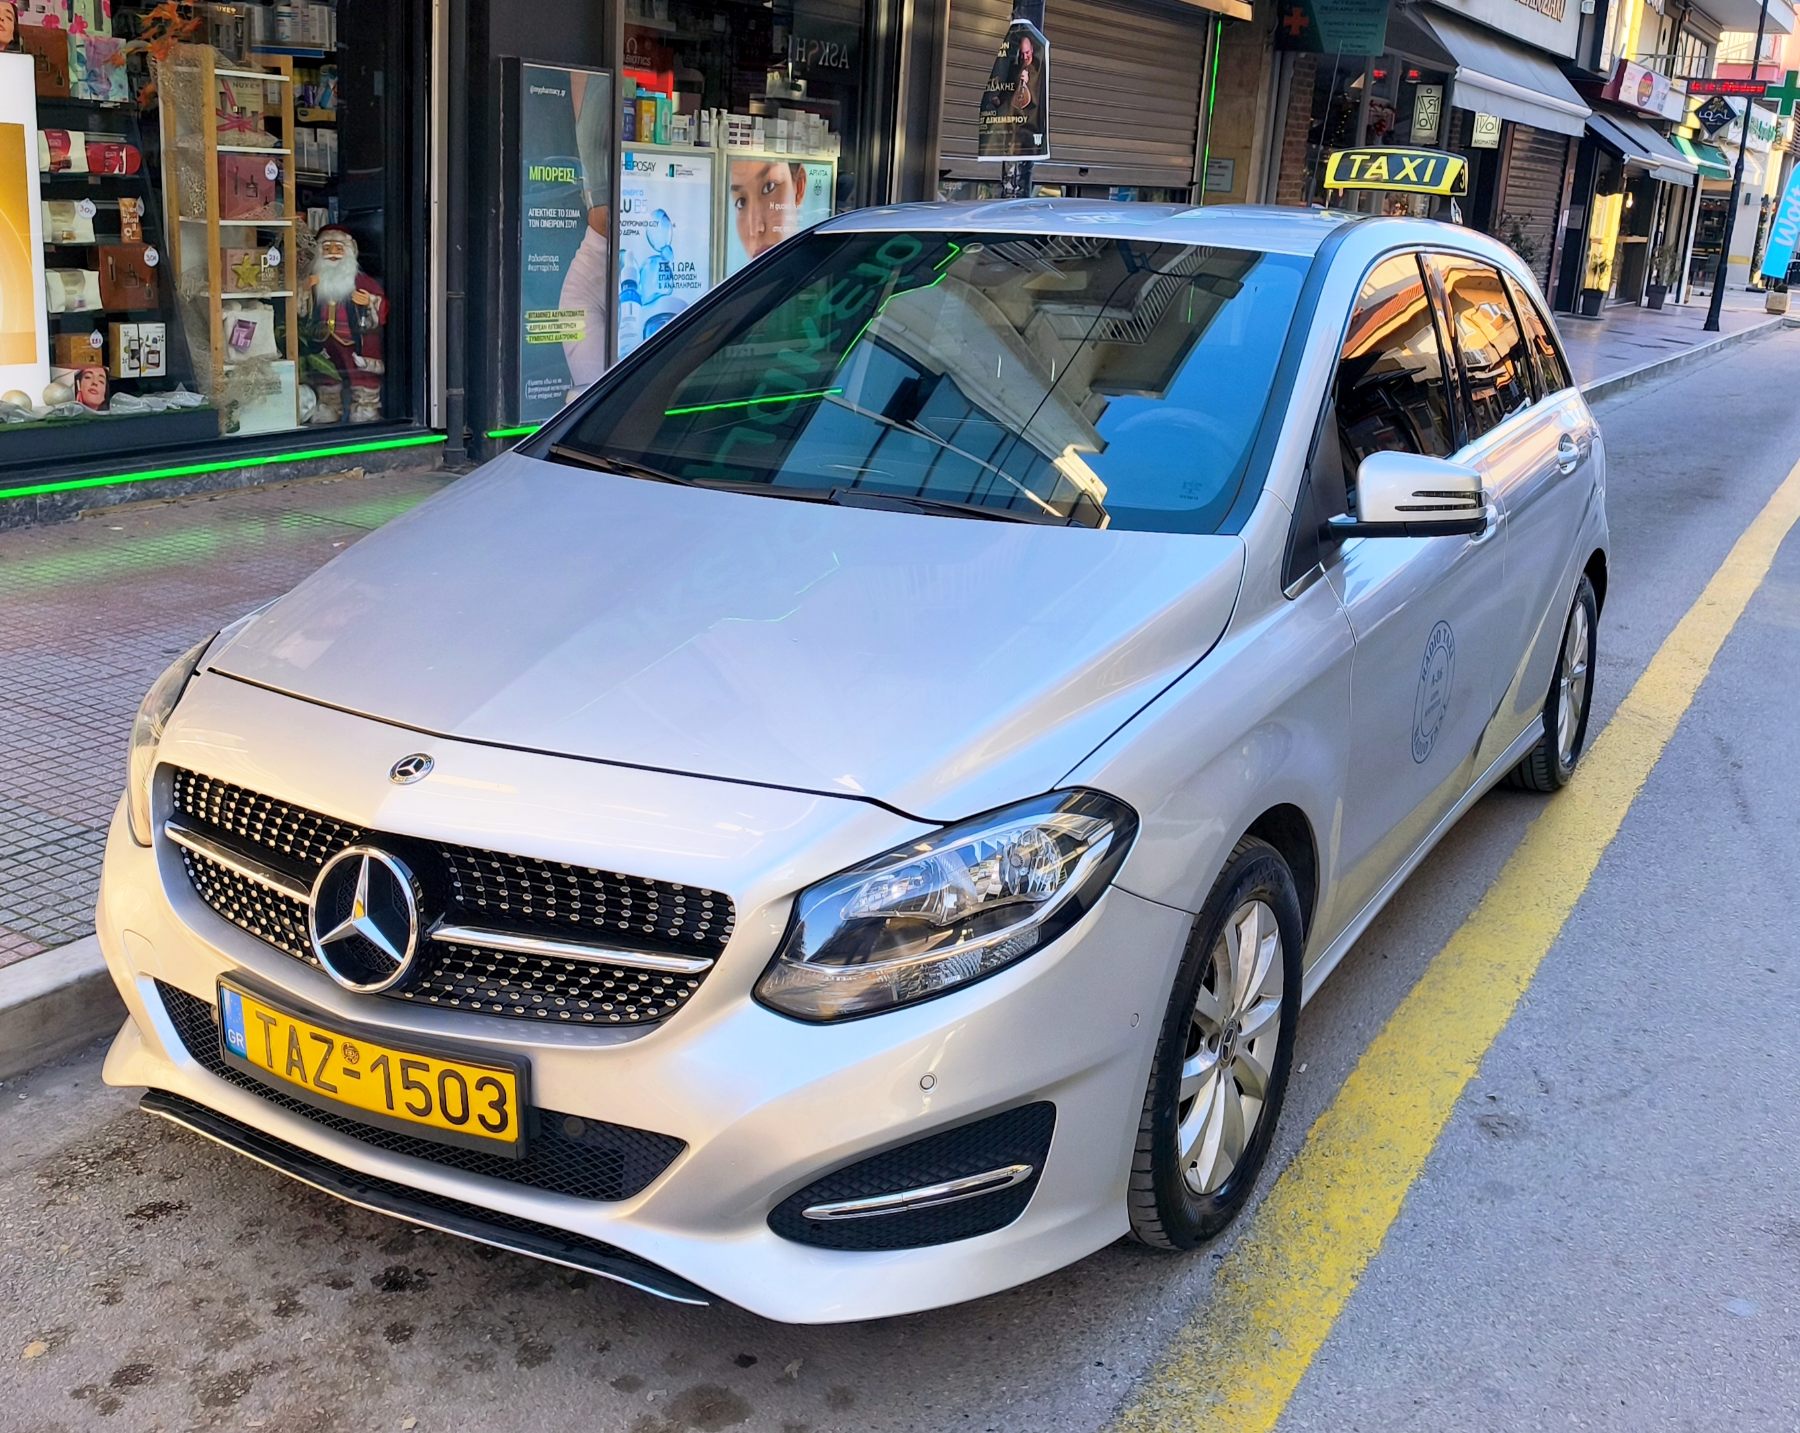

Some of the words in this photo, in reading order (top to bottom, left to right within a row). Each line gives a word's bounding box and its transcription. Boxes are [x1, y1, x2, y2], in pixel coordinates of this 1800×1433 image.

[985, 116, 1028, 124] ΔΕΚΕΜΒΡΙΟΥ
[1350, 154, 1437, 183] TAXI
[528, 208, 557, 217] ΑΠΕΚΤΗΣΕ
[558, 209, 565, 217] ΤΟ
[565, 209, 581, 218] ΣΩΜΑ
[1776, 184, 1800, 247] Wolt
[659, 262, 669, 273] ΣΕ
[677, 262, 695, 272] ΩΡΑ
[1421, 629, 1441, 682] RADIO
[227, 1028, 245, 1047] GR
